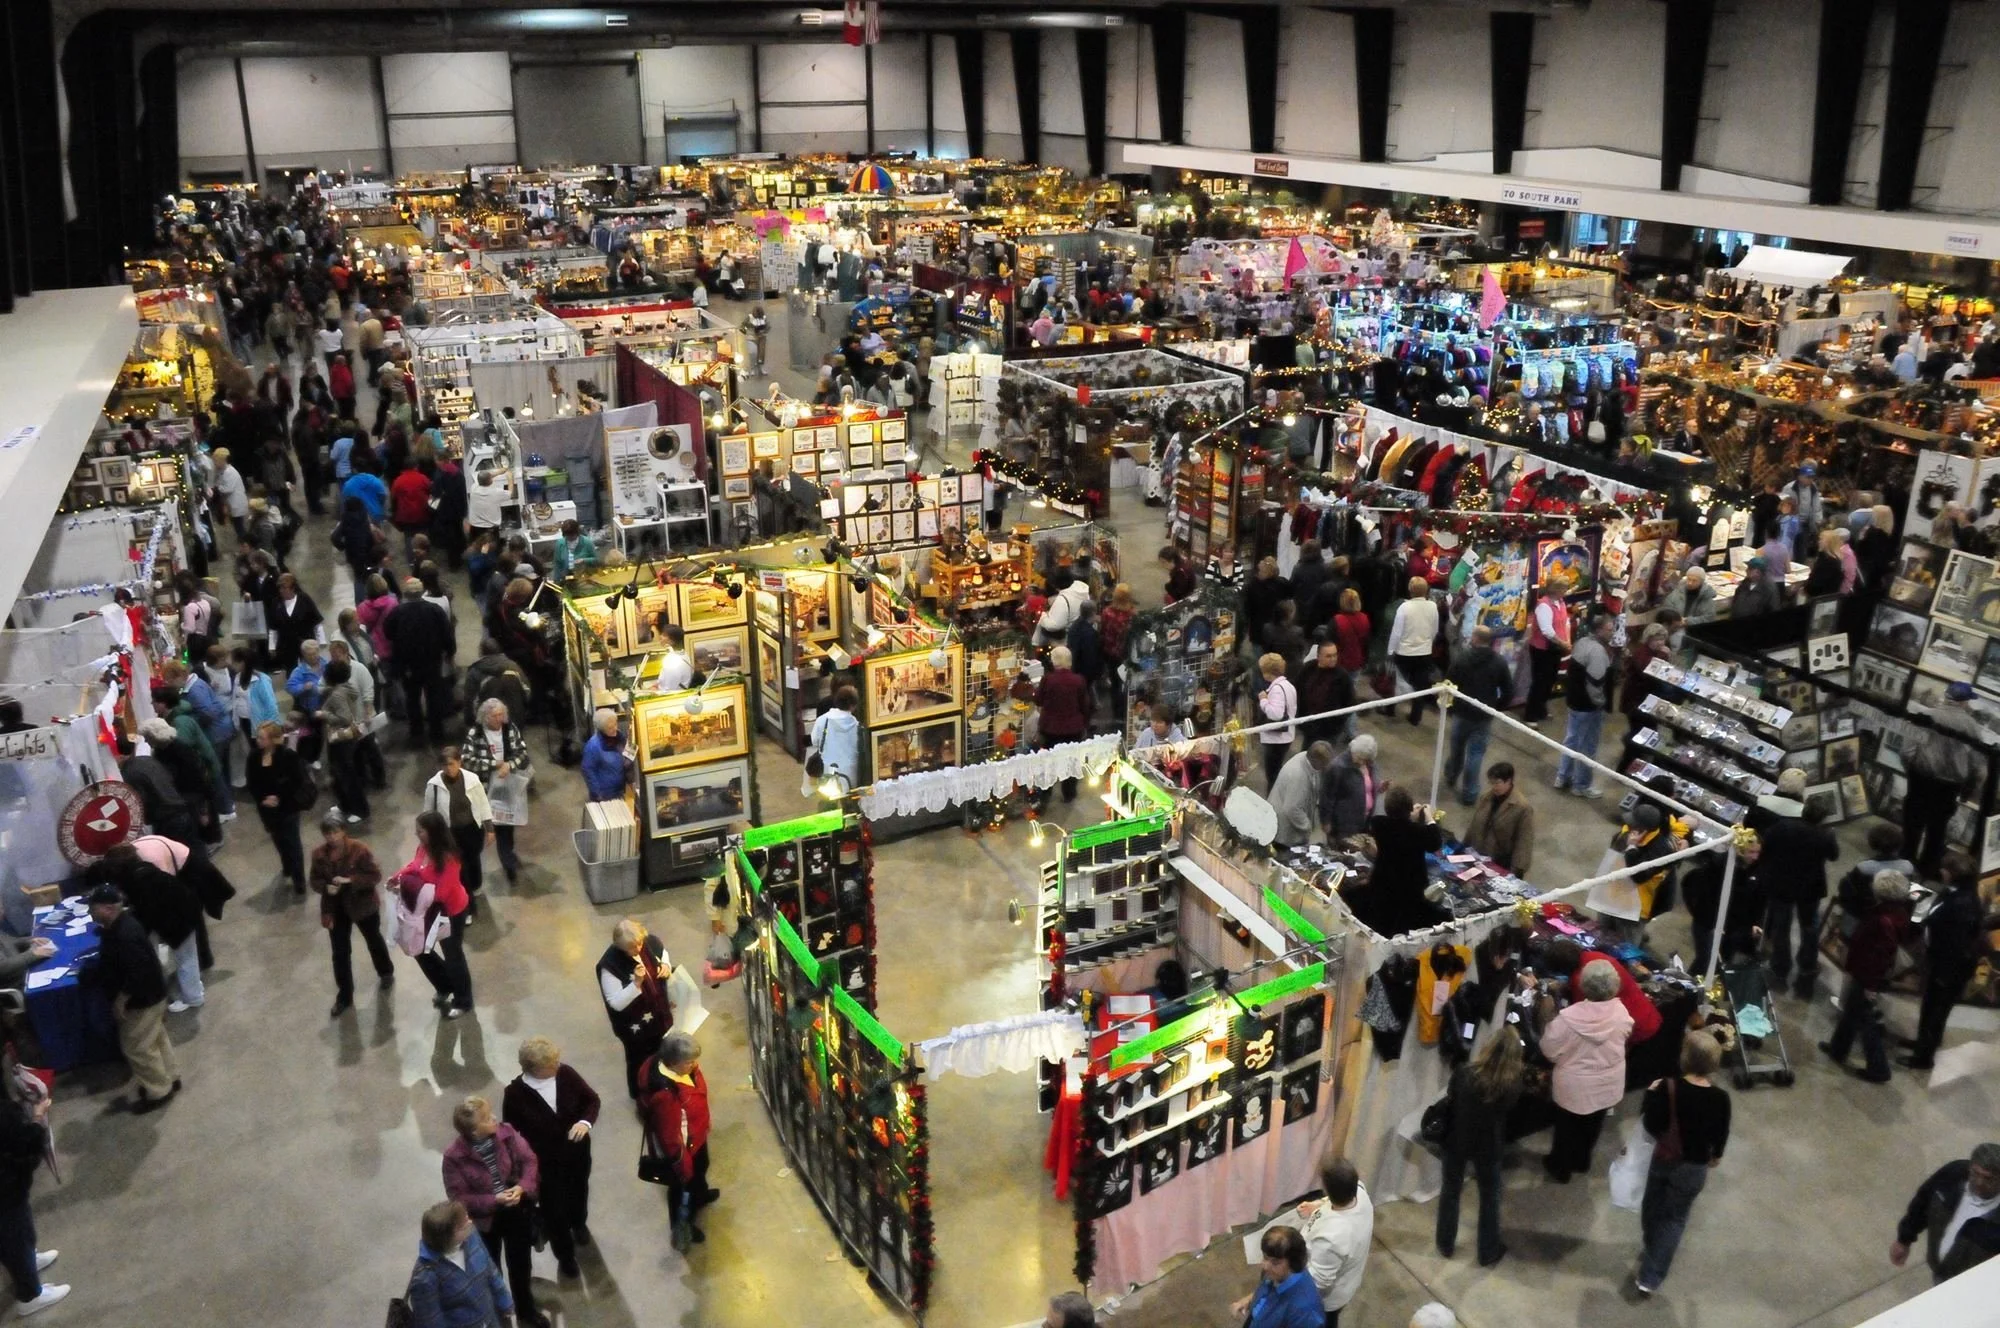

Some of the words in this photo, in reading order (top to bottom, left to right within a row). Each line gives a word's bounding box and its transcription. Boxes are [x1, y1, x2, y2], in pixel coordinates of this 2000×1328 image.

[1504, 190, 1515, 198] TO
[1519, 191, 1550, 202] SOUTH
[1554, 195, 1579, 206] PARK
